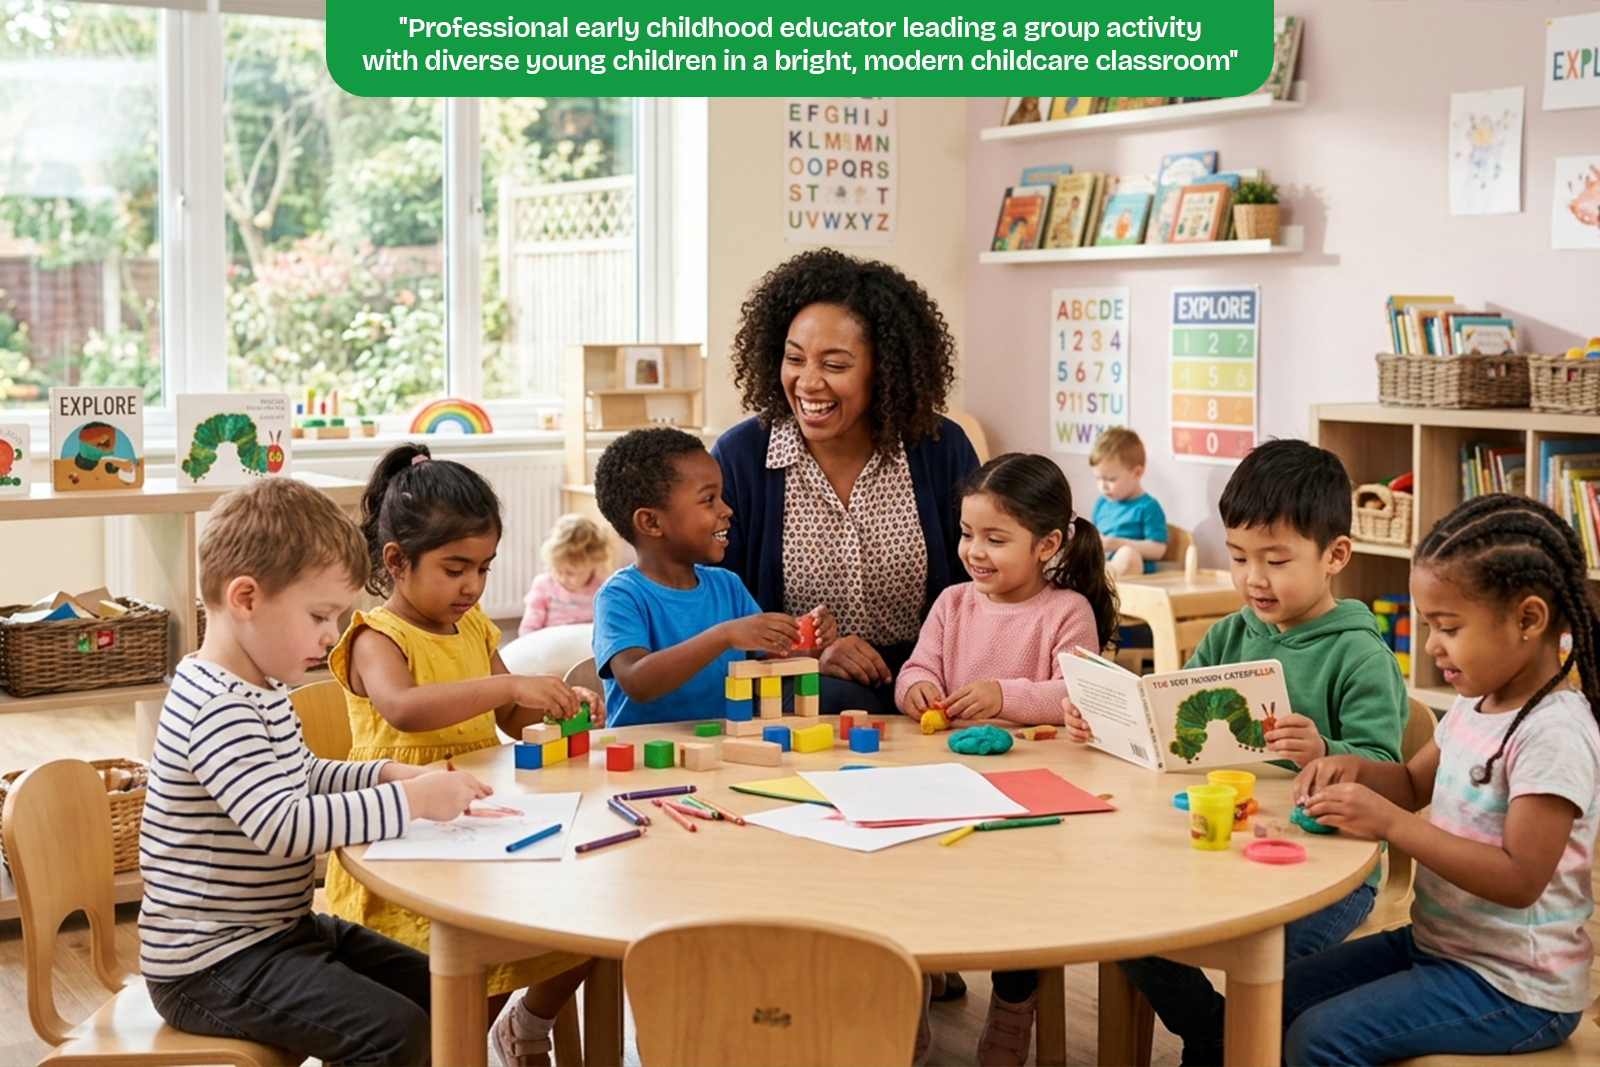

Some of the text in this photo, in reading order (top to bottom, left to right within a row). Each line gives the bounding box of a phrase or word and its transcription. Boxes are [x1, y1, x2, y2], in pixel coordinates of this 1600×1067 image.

[1178, 296, 1251, 320] EXPLORE
[60, 395, 137, 416] EXPLORE
[1207, 398, 1218, 421] 8
